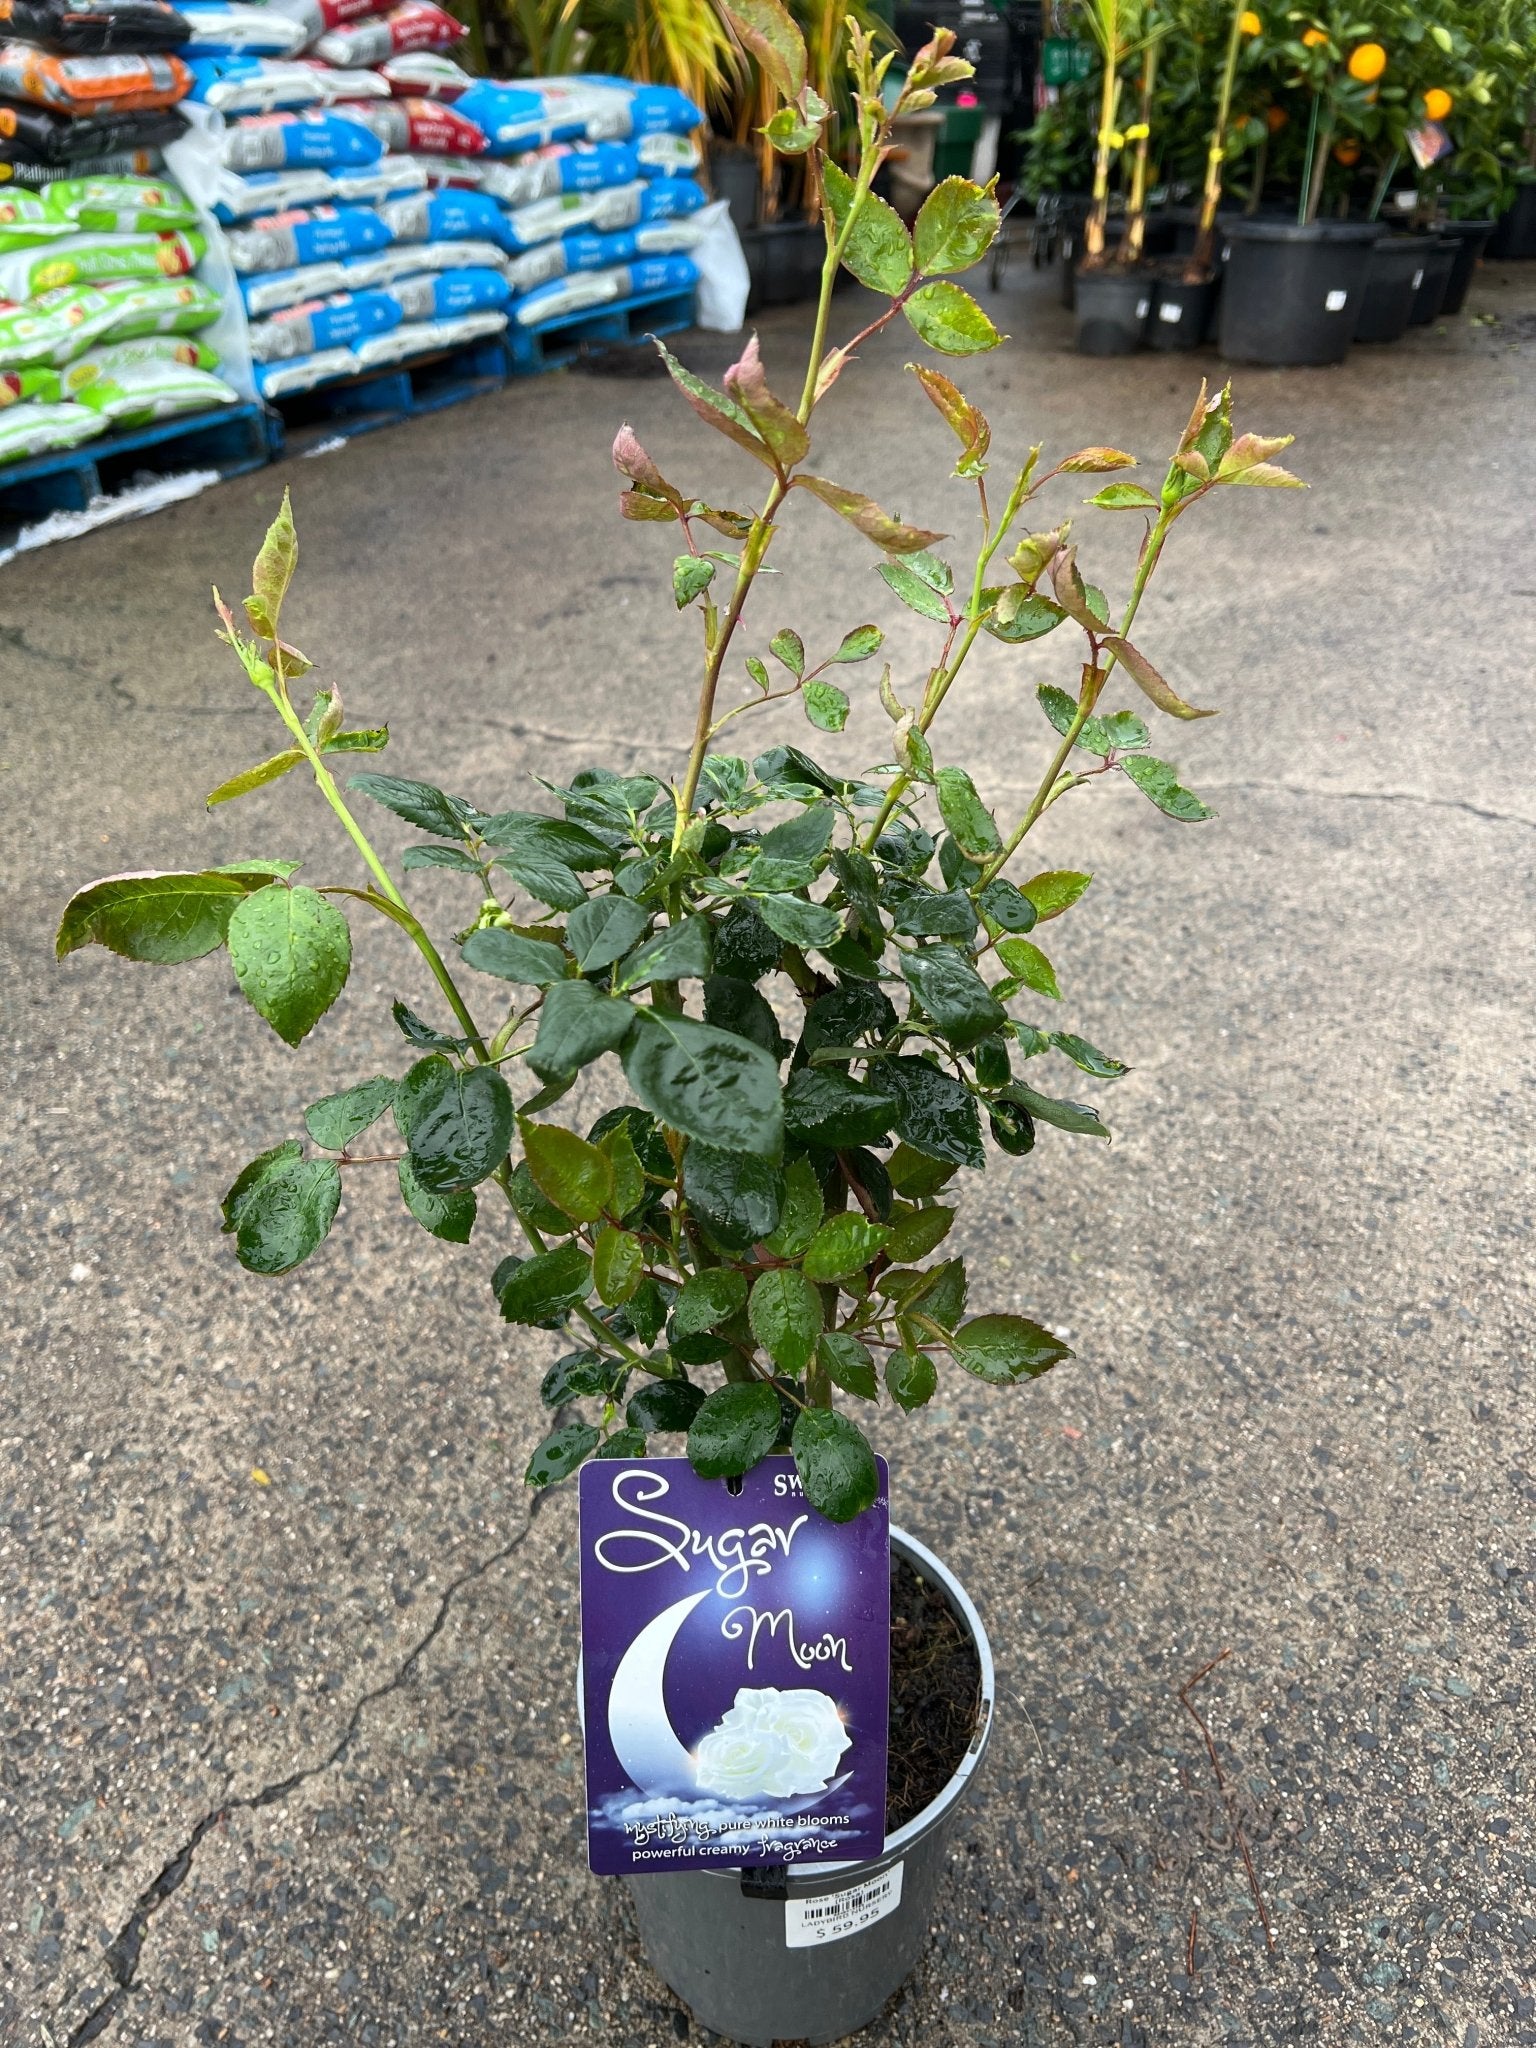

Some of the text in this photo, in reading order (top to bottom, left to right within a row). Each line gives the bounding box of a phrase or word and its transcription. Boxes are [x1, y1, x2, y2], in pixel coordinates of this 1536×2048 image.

[594, 1469, 809, 1599] Sugar
[721, 1605, 853, 1673] Moon
[719, 1820, 751, 1834] pure
[756, 1815, 794, 1829] white
[798, 1814, 850, 1827] blooms
[632, 1834, 838, 1862] powerful creamy fragrance
[801, 1912, 850, 1928] LADYBIRD
[851, 1890, 893, 1916] NURSERY
[805, 1896, 829, 1905] Rose
[816, 1928, 826, 1939] $
[831, 1908, 880, 1935] 59.95
